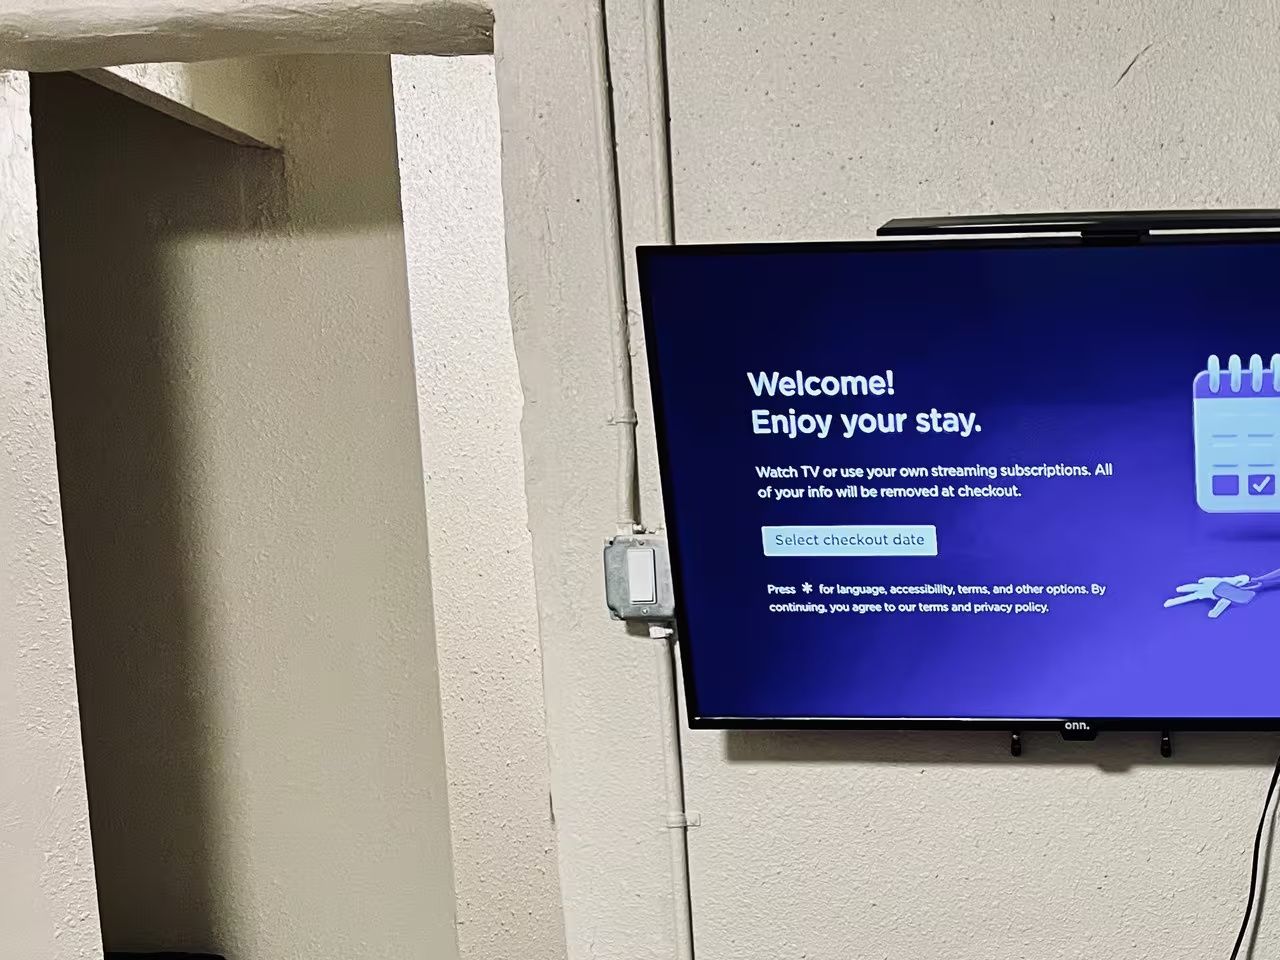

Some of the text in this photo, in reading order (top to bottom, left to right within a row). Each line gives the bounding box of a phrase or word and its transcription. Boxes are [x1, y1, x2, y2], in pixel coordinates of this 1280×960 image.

[746, 370, 895, 397] Welcome!
[751, 408, 982, 439] Enjoy your stay.
[755, 462, 1113, 480] Watch TV or use your own streaming subscriptions. All
[757, 484, 1022, 500] of your info will be removed at checkout.
[775, 533, 925, 546] Select checkout date
[767, 583, 1106, 596] Press for language, accessibility, terms, and other options. By
[769, 602, 1049, 614] continuing, you agree to our terms and privacy policy.
[1064, 721, 1091, 730] onn.
